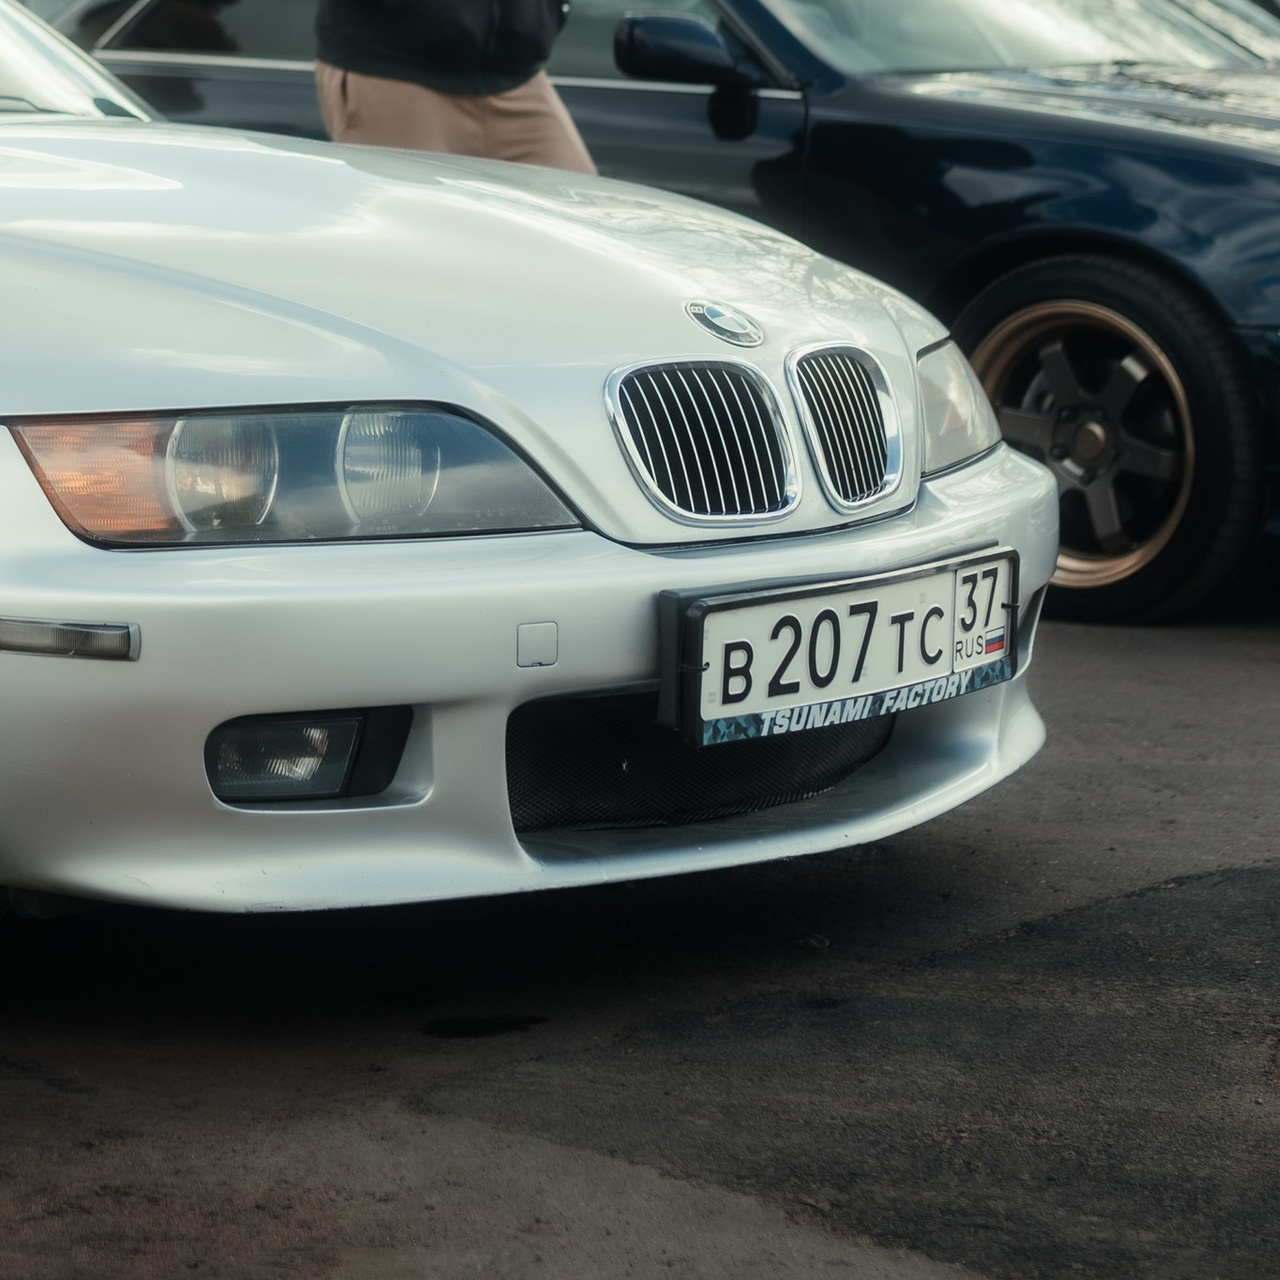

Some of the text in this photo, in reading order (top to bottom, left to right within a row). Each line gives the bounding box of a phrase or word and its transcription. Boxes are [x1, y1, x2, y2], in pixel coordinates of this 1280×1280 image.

[960, 567, 999, 632] 37
[955, 635, 984, 662] RUS
[760, 671, 972, 737] TSUNAMI FACTORY
